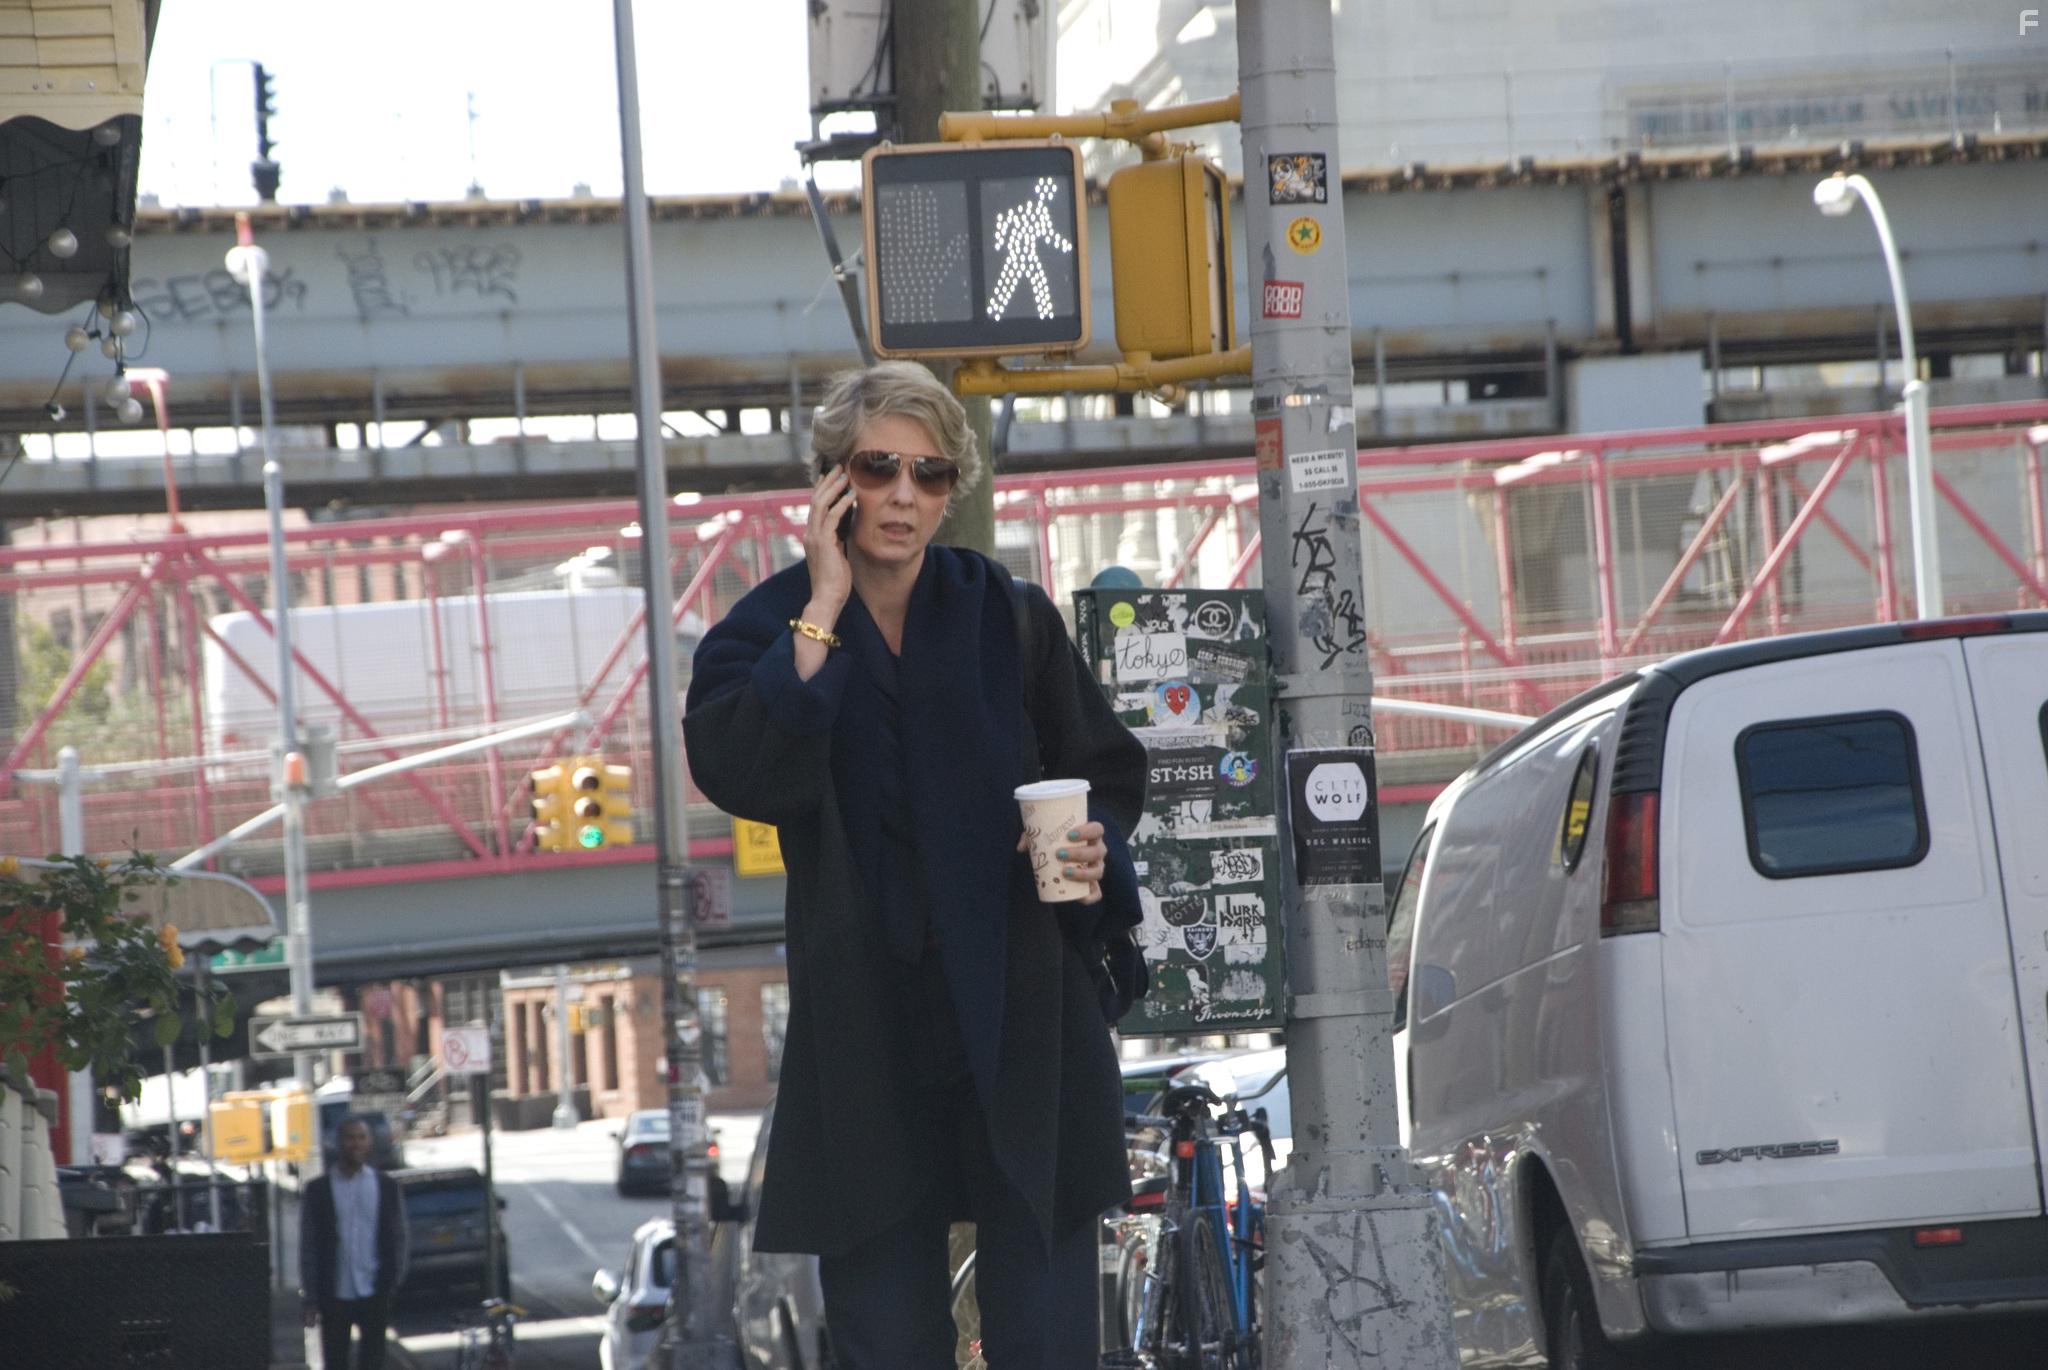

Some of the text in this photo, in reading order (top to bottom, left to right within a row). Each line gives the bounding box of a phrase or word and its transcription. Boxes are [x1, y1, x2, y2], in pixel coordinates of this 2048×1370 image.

[1264, 285, 1302, 301] GOOD
[1264, 299, 1301, 314] FOOD
[1291, 455, 1310, 464] NEED
[1311, 454, 1316, 462] A
[1314, 466, 1331, 475] CALL
[1314, 779, 1361, 792] CITY
[1314, 793, 1362, 805] WOLF
[1305, 836, 1372, 847] DOG WALKING
[1695, 1138, 1841, 1166] EXPRESS
